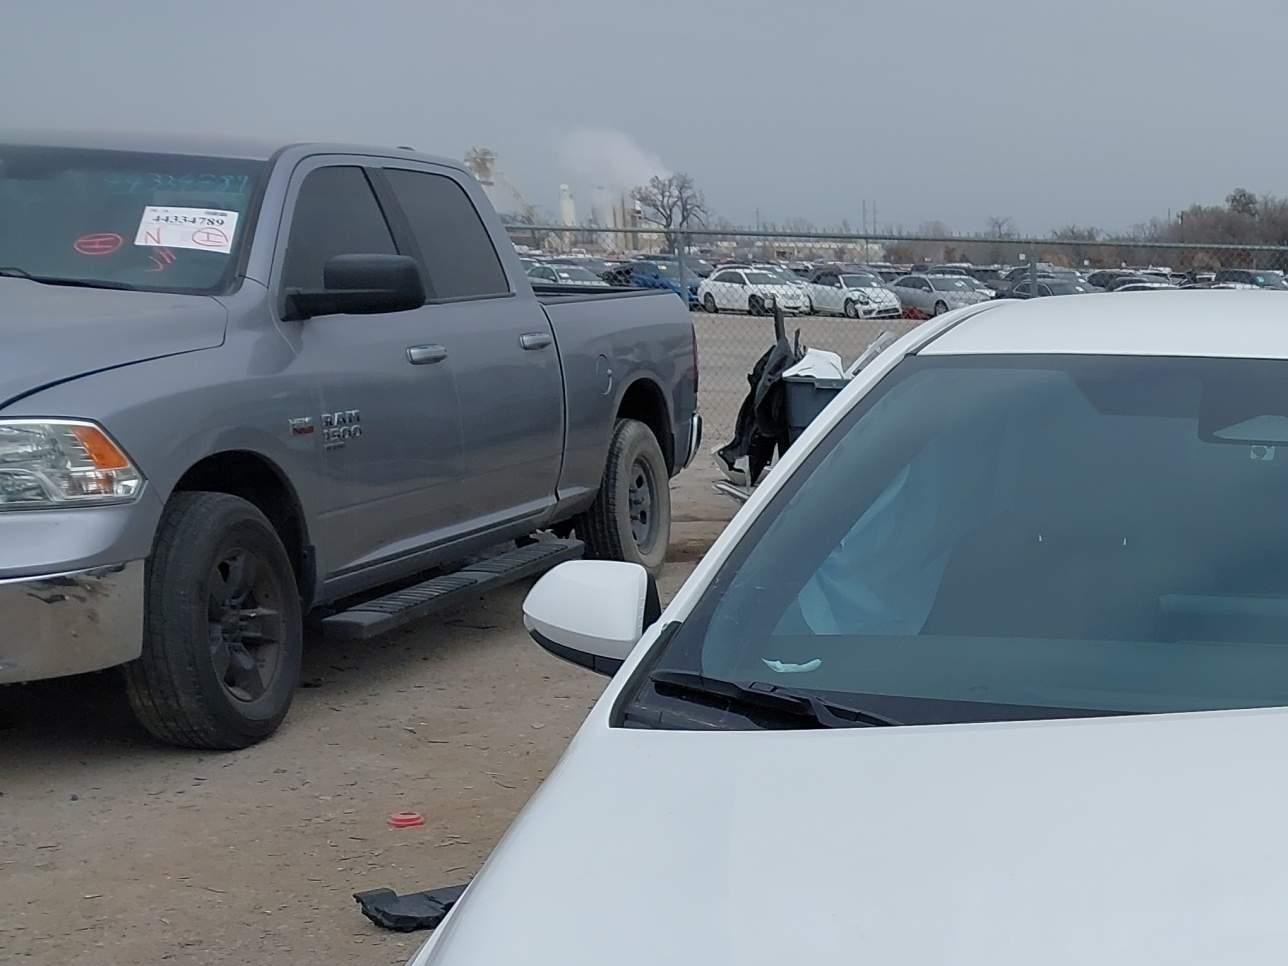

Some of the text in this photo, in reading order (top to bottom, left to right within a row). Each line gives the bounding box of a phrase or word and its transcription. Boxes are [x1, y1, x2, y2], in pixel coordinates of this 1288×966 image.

[151, 215, 225, 226] 44334789
[321, 409, 361, 427] RAM
[322, 424, 362, 442] 1500
